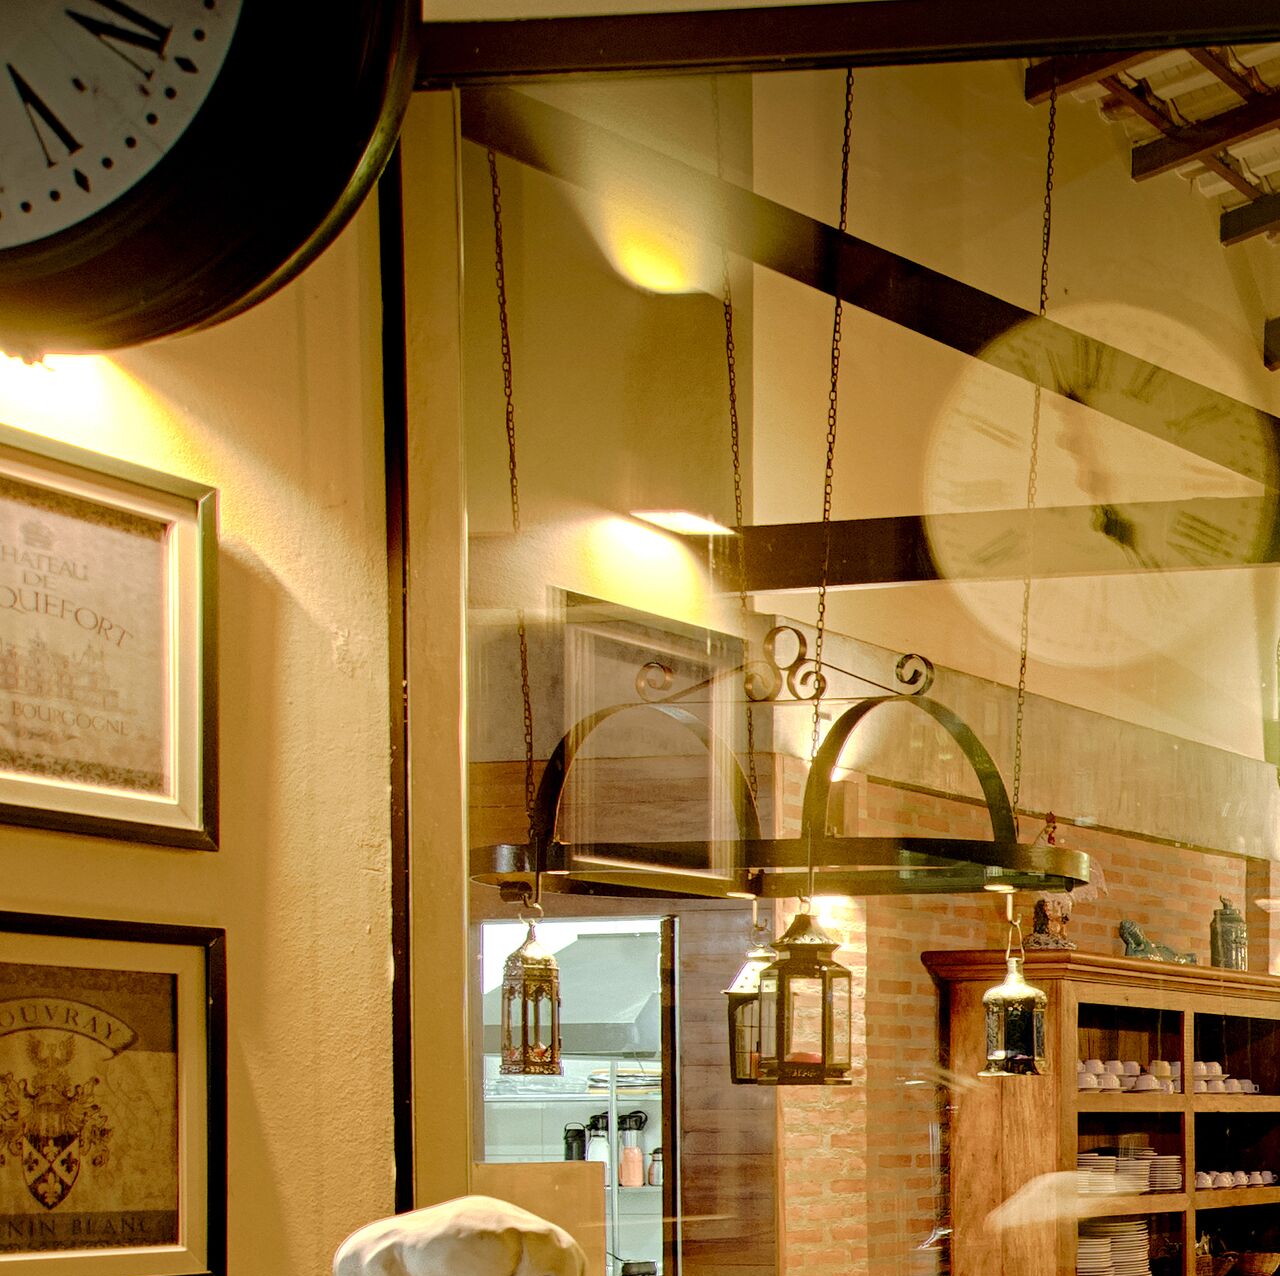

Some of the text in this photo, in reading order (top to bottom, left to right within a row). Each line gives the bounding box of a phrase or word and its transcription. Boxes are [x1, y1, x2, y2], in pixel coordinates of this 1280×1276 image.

[23, 569, 57, 591] DE
[11, 700, 129, 737] BOURGOGNE
[0, 1003, 120, 1040] OUVRAY
[71, 1216, 150, 1236] BLANC
